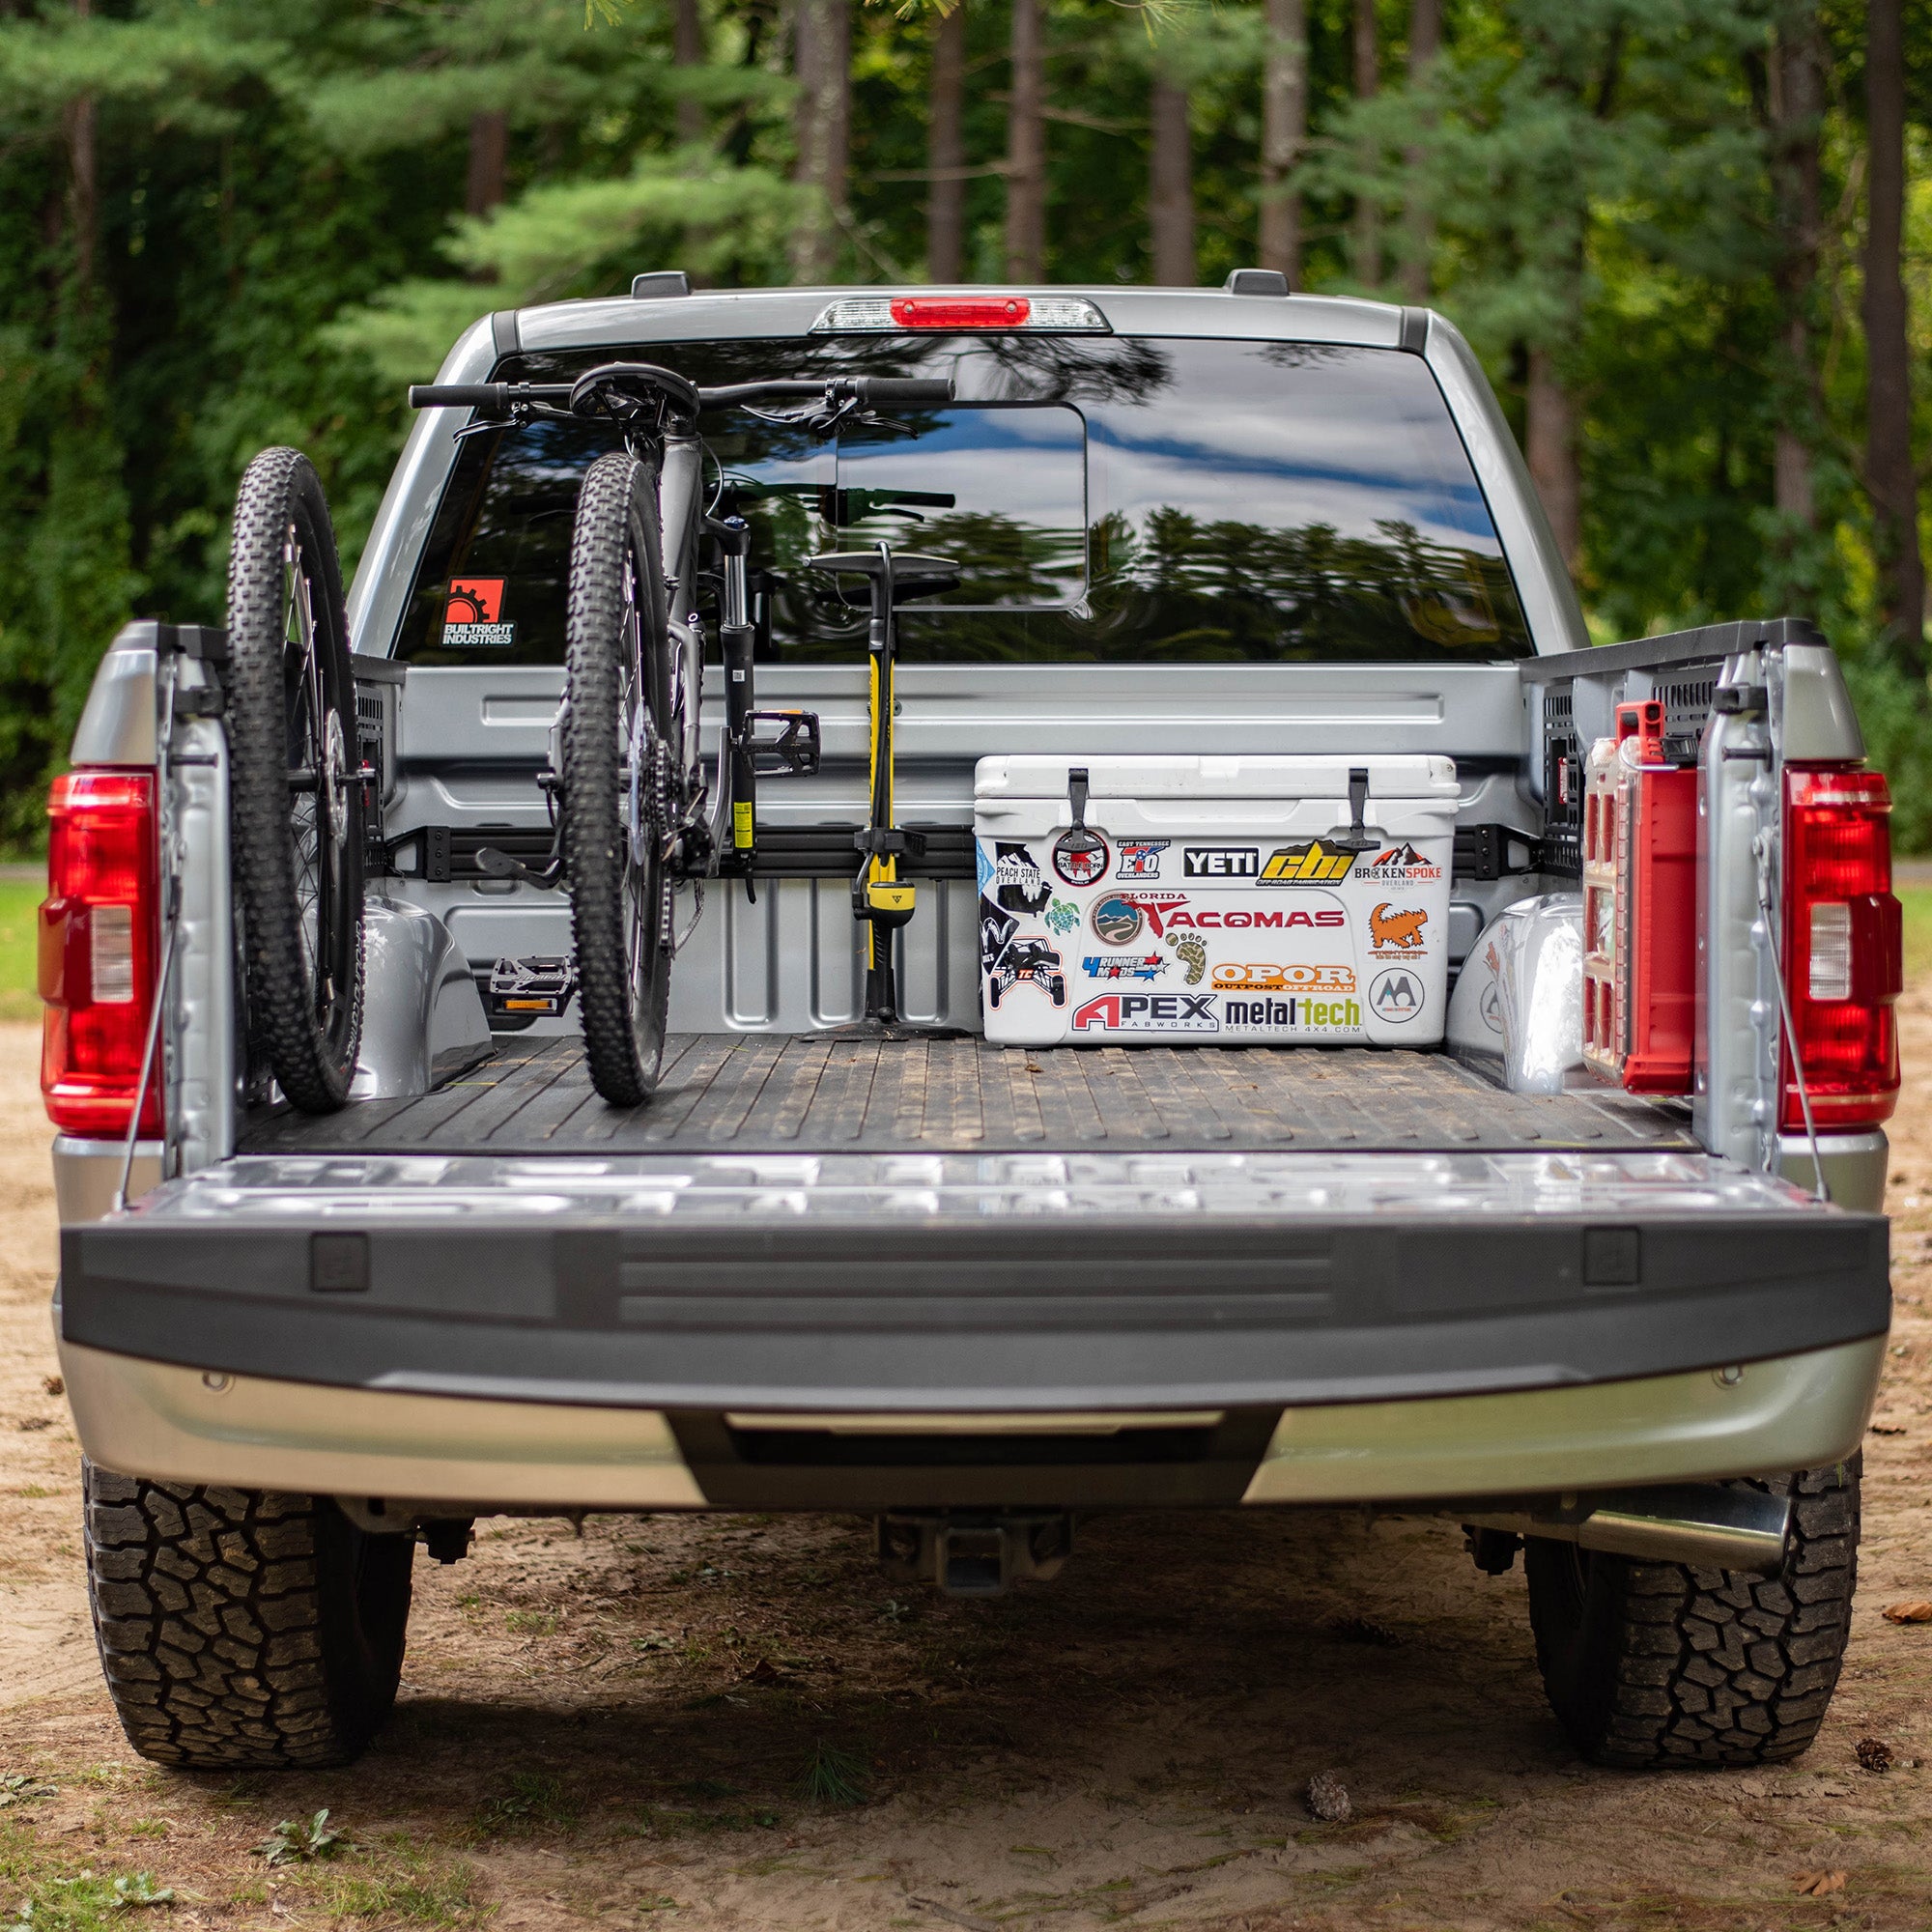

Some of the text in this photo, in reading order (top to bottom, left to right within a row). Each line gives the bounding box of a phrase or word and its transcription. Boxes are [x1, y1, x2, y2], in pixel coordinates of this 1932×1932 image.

[443, 623, 514, 634] BUILTRIGHT
[442, 634, 512, 644] INDUSTRIES
[1186, 852, 1255, 873] YETI
[996, 867, 1040, 879] PEACH STATE
[996, 876, 1041, 885] OVERLAND
[1213, 964, 1354, 984] OPOR
[1075, 996, 1212, 1028] APEX
